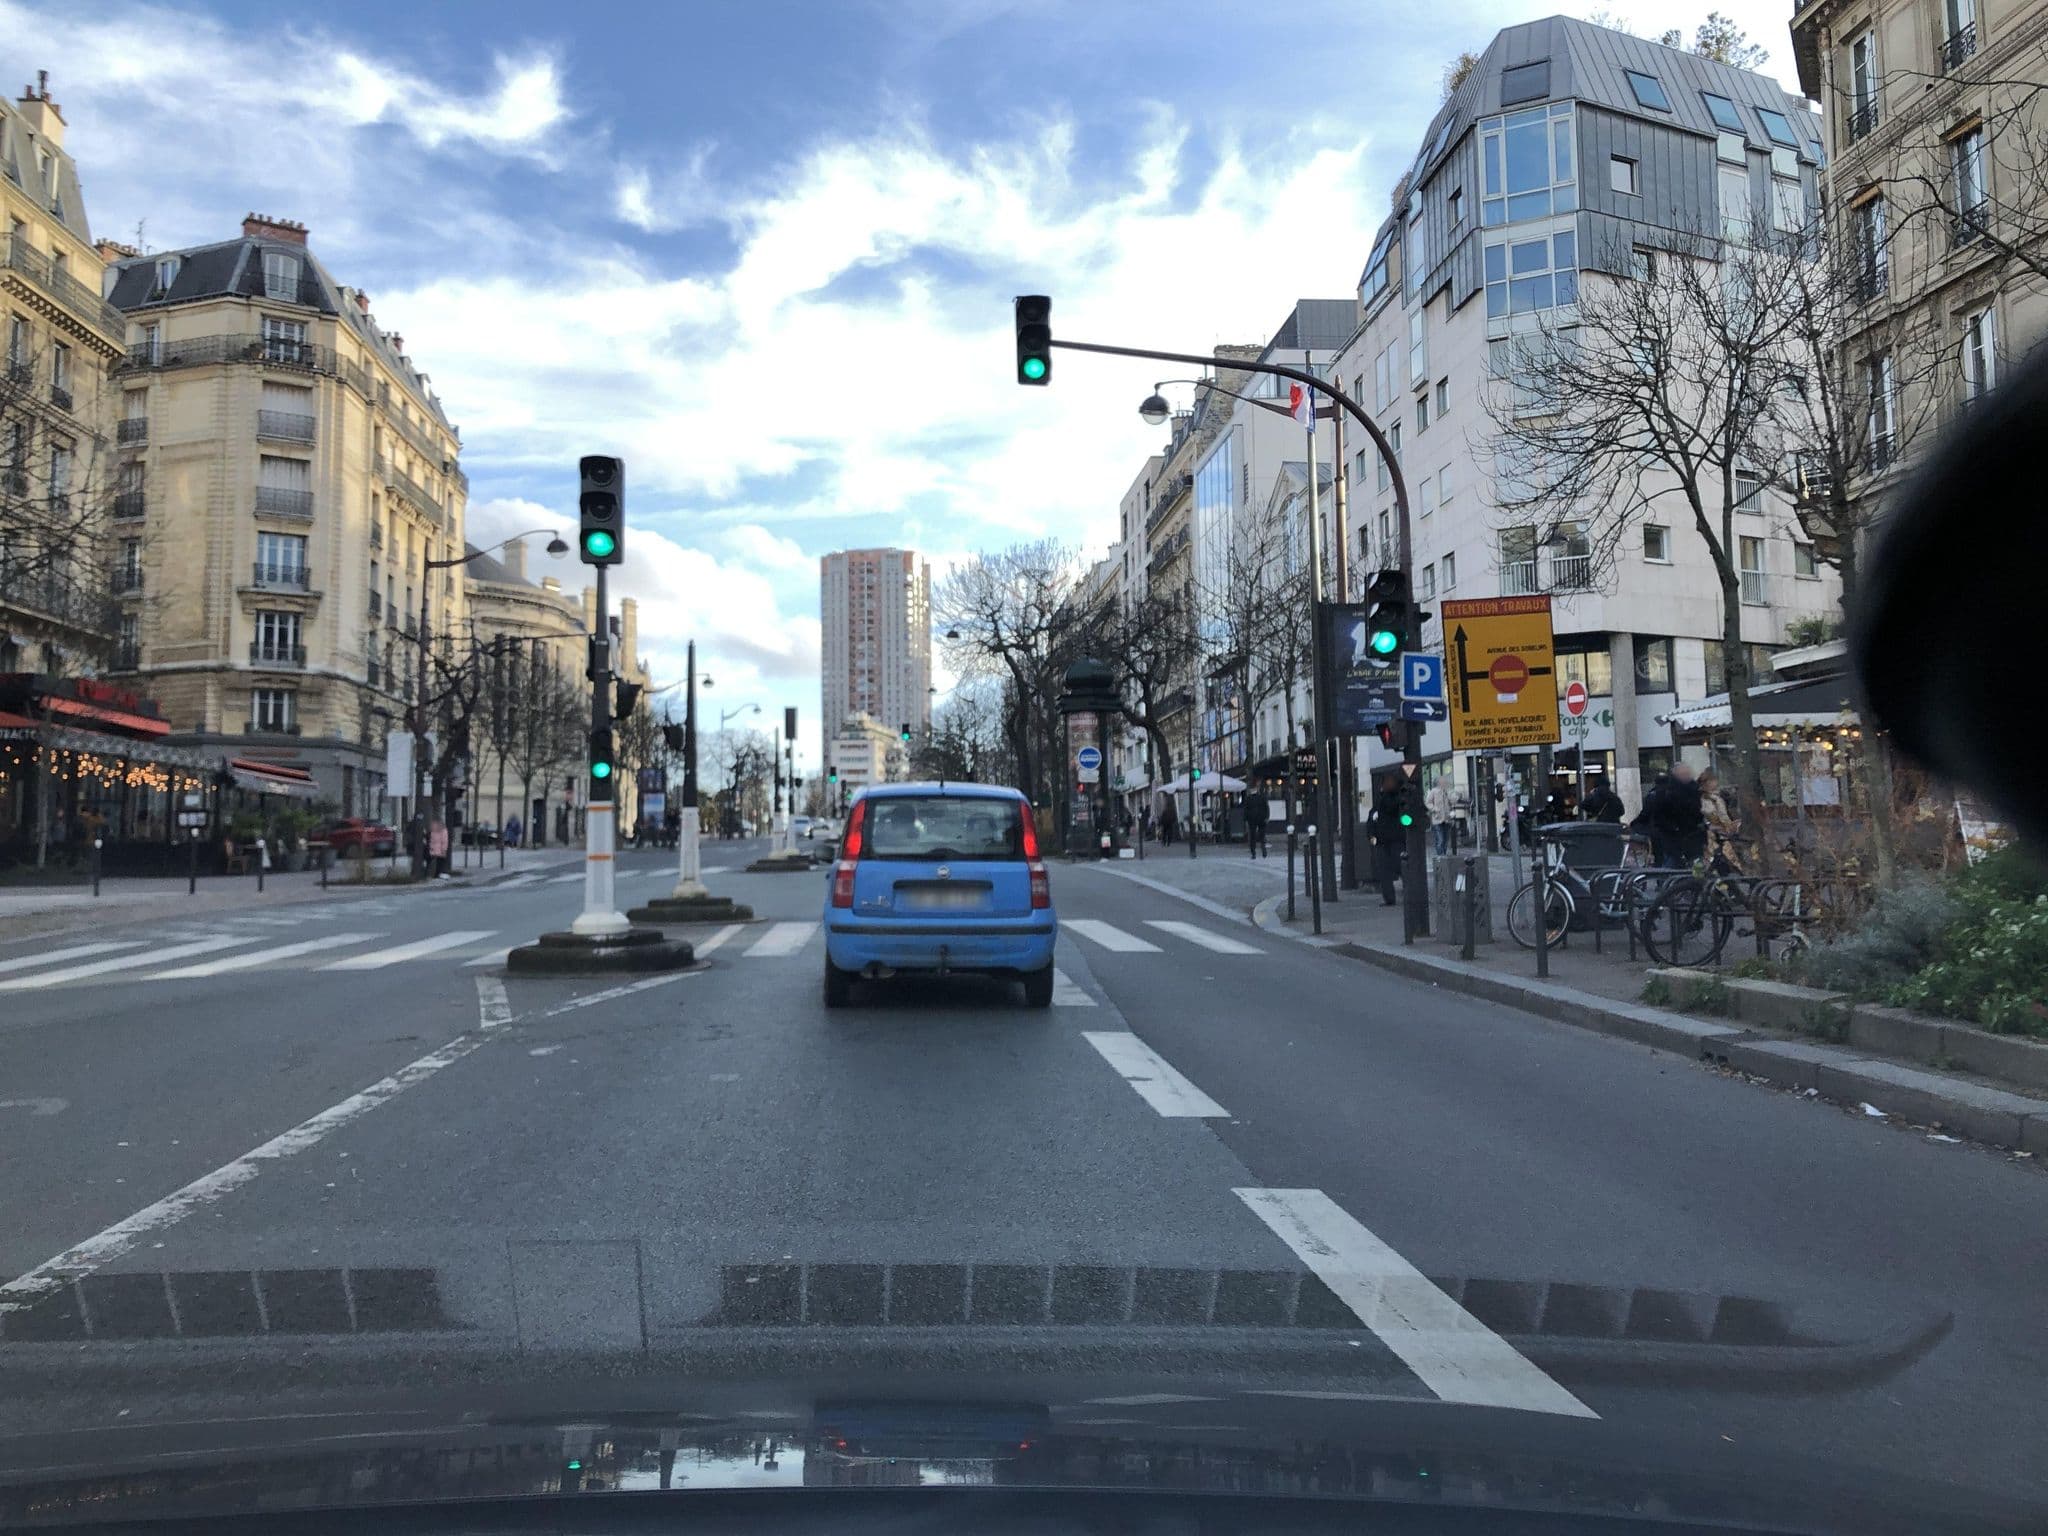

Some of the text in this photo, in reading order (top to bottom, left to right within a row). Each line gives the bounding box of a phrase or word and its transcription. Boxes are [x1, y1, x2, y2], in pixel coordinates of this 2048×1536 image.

[1445, 599, 1547, 616] ATTENTION TRAVAUX
[1413, 662, 1432, 691] P
[1463, 719, 1477, 727] RUE
[1479, 718, 1496, 726] ABEL
[1513, 724, 1544, 733] TRAVAUX
[1463, 736, 1496, 746] COMPTER
[1498, 736, 1508, 744] DU
